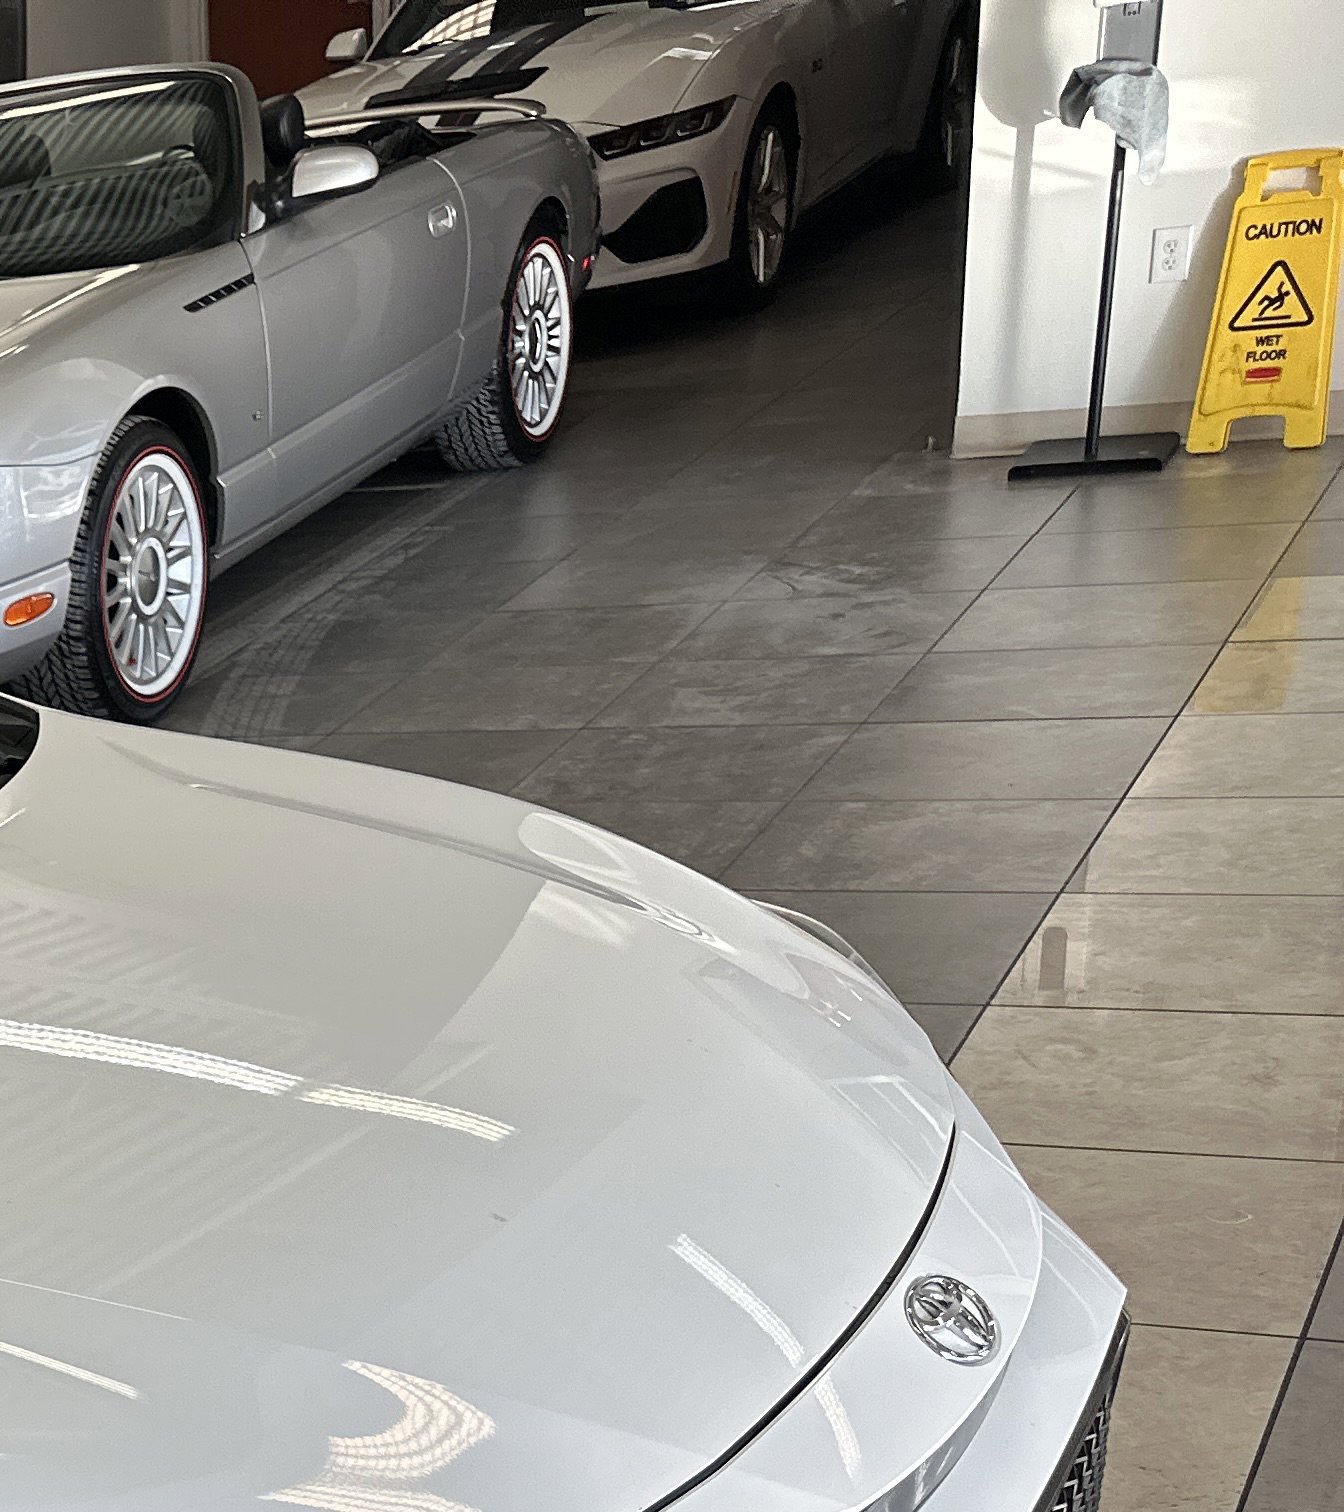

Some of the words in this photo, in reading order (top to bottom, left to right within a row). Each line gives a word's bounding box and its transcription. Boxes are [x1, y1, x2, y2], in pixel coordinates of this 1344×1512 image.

[1245, 218, 1323, 241] CAUTION
[1255, 334, 1283, 347] WET
[1245, 349, 1287, 363] FLOOR
